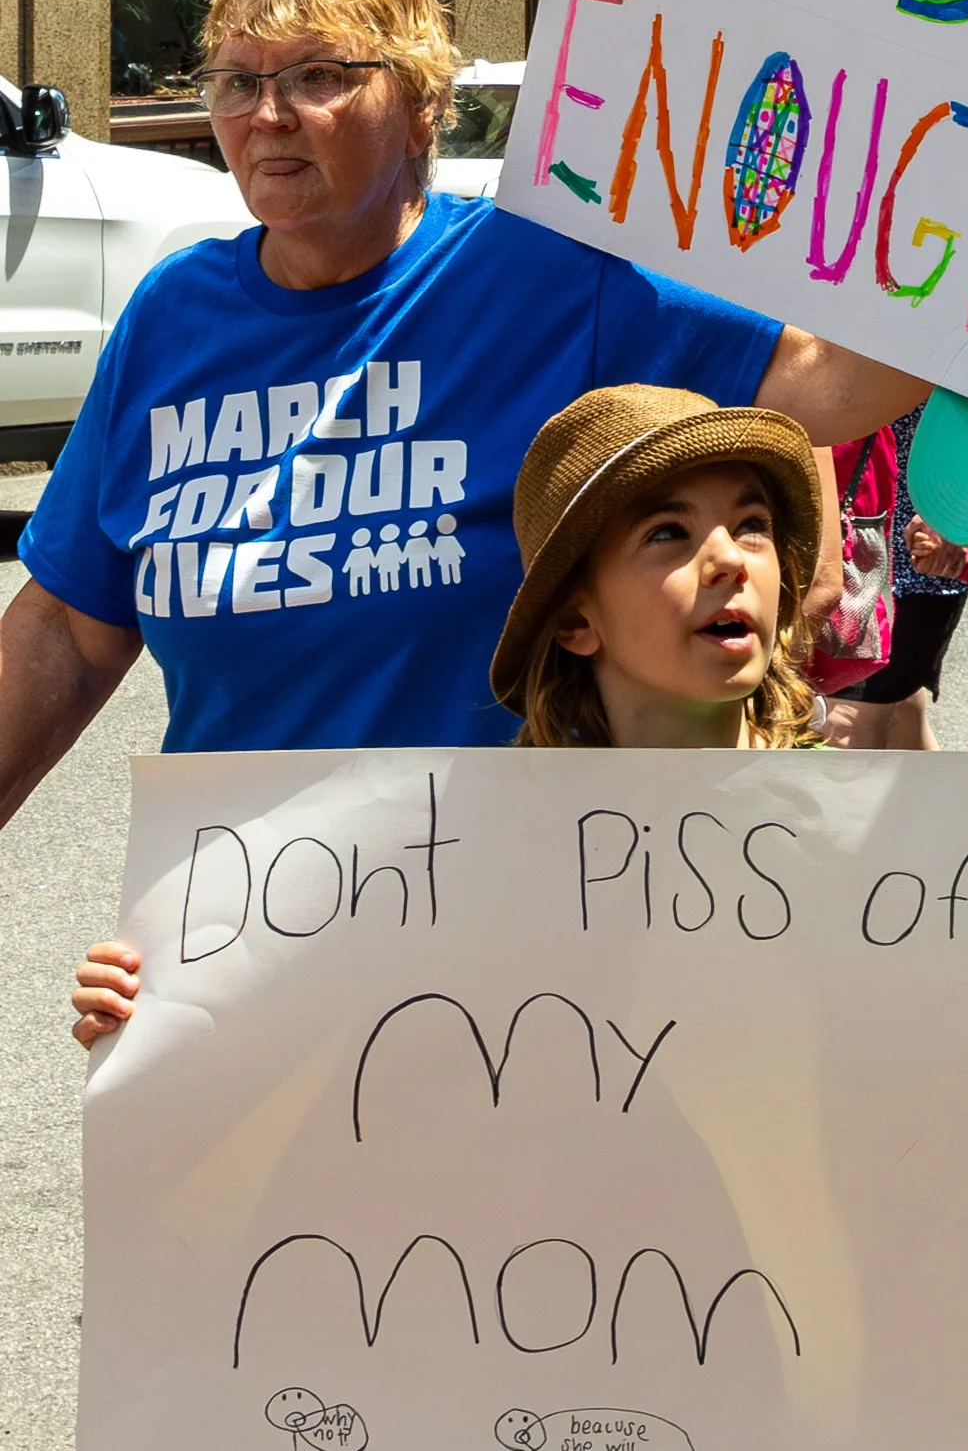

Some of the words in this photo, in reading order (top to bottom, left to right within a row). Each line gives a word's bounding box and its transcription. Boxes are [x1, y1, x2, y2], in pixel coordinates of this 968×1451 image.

[149, 360, 421, 481] MARCH
[129, 464, 280, 548] FOR
[290, 440, 467, 527] OUR
[135, 532, 336, 618] LIVES
[570, 1414, 650, 1442] beacuse
